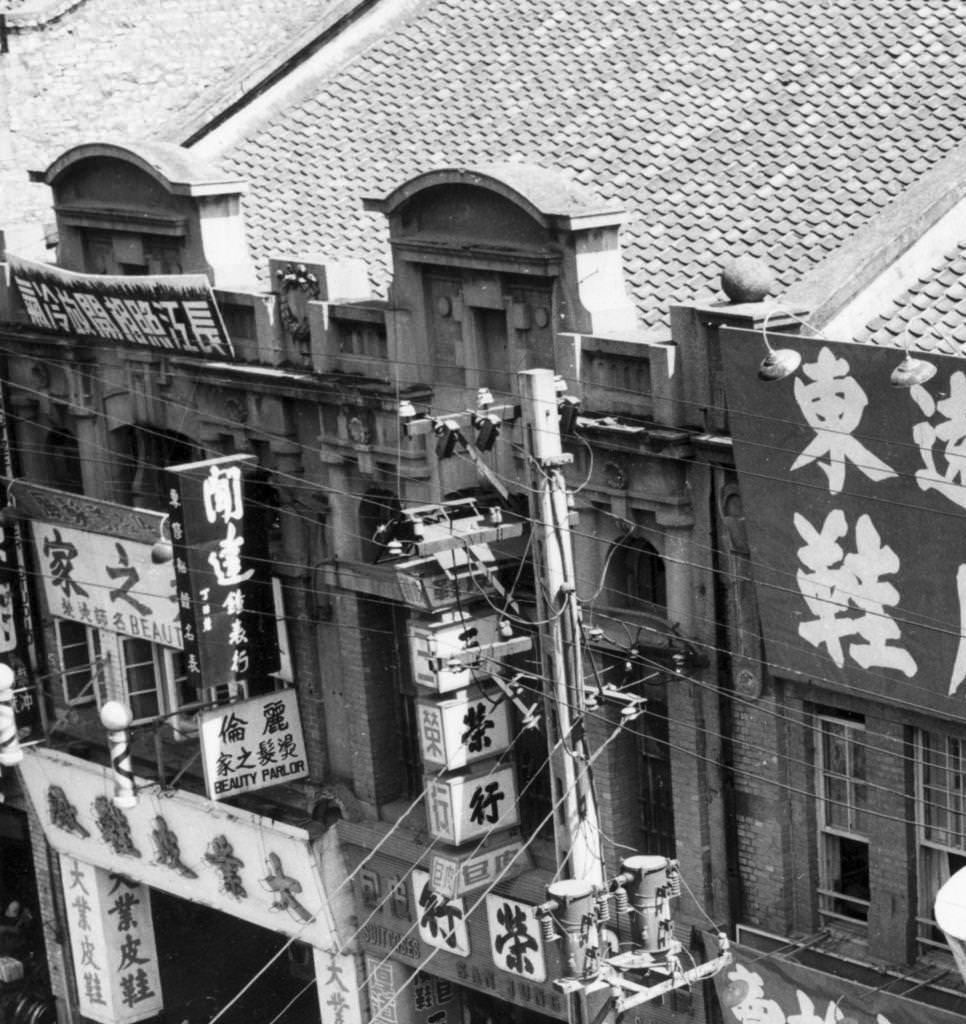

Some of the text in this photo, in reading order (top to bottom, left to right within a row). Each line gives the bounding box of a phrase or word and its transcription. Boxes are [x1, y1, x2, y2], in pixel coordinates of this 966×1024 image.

[214, 759, 305, 794] BEAUTY PARLOR
[70, 861, 107, 1006] 大業皮鞋
